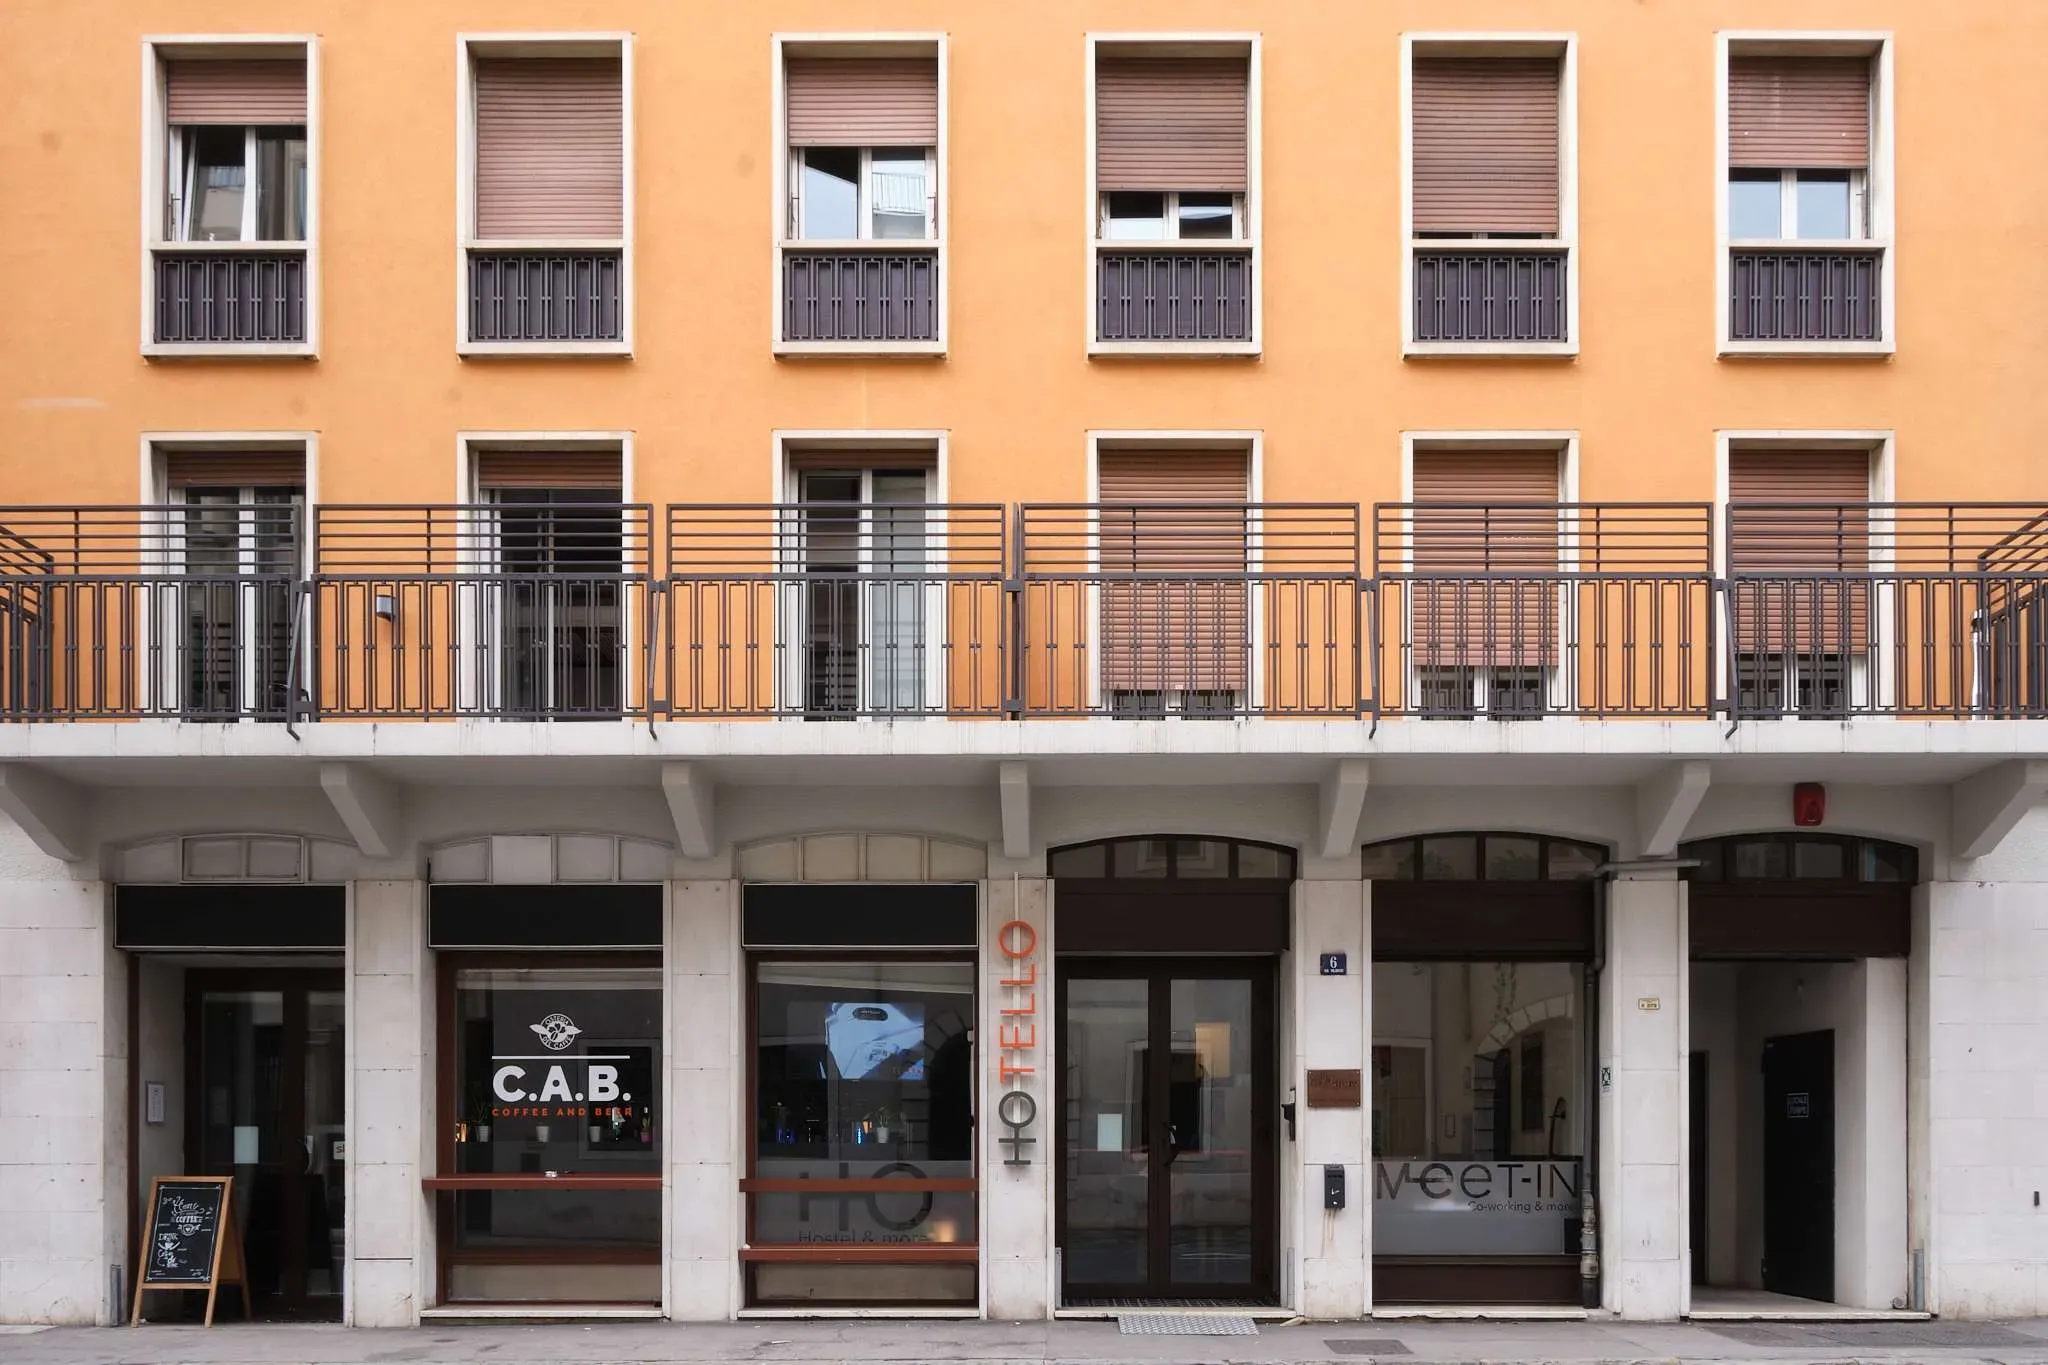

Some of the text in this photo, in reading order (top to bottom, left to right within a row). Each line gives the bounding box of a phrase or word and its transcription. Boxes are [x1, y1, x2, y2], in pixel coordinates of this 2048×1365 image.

[1330, 955, 1338, 969] 6
[999, 920, 1036, 1165] HOTELLO
[493, 1065, 632, 1103] C.A.B.
[492, 1107, 633, 1118] COFFEE AND BEER
[1534, 1200, 1544, 1212] &
[799, 1230, 856, 1242] Hostel
[862, 1230, 874, 1242] &
